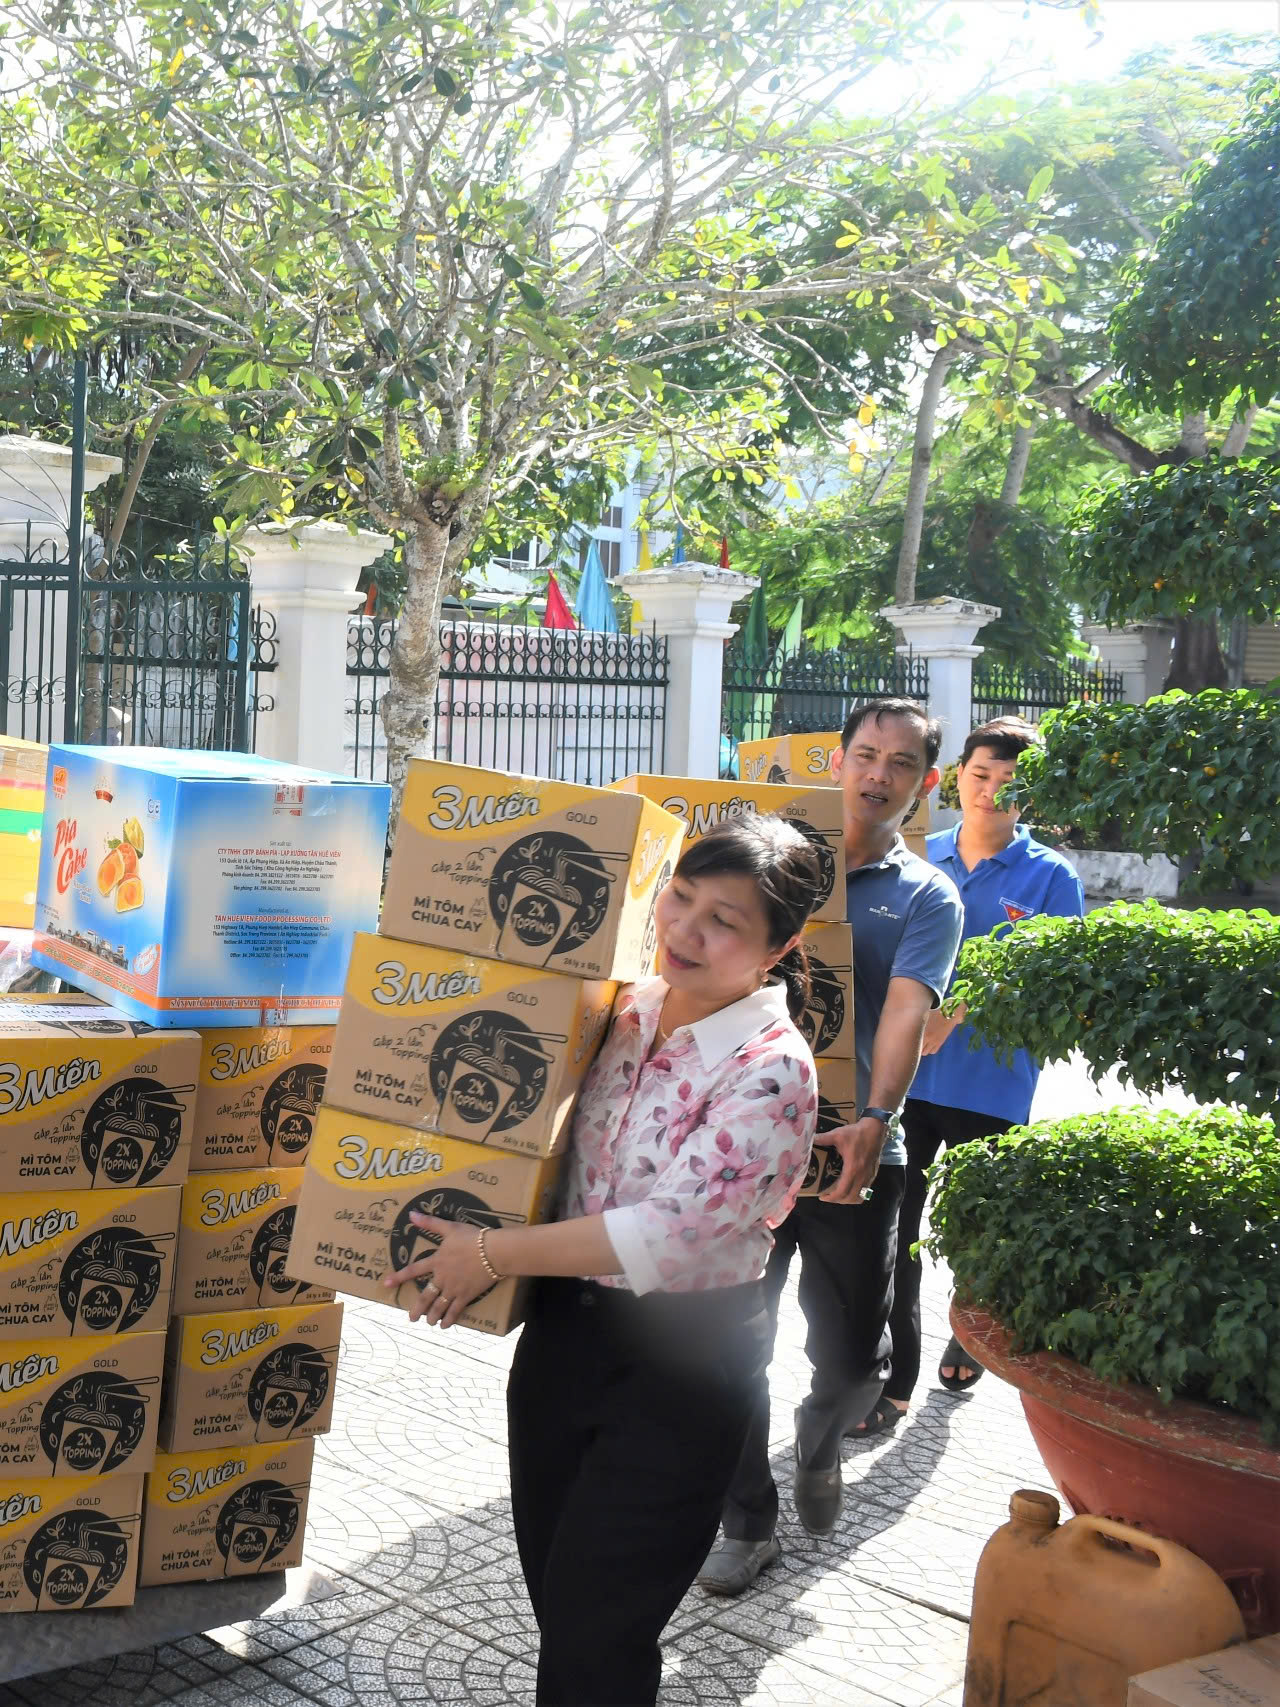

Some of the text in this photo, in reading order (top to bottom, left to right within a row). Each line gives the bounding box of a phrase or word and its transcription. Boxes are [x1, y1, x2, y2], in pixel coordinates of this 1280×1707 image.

[566, 811, 598, 826] GOLD
[786, 808, 806, 816] GOLD
[414, 895, 464, 915] MÌ TÔM
[528, 900, 548, 918] 2X
[411, 911, 482, 933] CHUA CAY
[512, 913, 555, 937] TOPPING
[506, 992, 538, 1007] GOLD
[311, 1046, 333, 1054] GOLD
[135, 1065, 158, 1074] GOLD
[376, 1073, 405, 1090] TÔM
[353, 1083, 423, 1108] CHUA CAY
[289, 1117, 303, 1132] 2X
[221, 1131, 243, 1144] TÔM
[278, 1132, 309, 1144] TOPPING
[115, 1143, 131, 1157] 2X
[204, 1144, 257, 1156] CHUA CAY
[20, 1153, 62, 1166] MÌ TÔM
[103, 1158, 138, 1170] TOPPING
[19, 1166, 77, 1177] CHUA CAY
[468, 1170, 499, 1186] GOLD
[112, 1214, 135, 1223] GOLD
[337, 1246, 366, 1264] TÔM
[314, 1255, 383, 1282] CHUA CAY
[14, 1302, 39, 1313] TÔM
[32, 1314, 55, 1323] CAY
[297, 1325, 318, 1334] GOLD
[94, 1359, 118, 1368] GOLD
[13, 1455, 36, 1463] CAY
[266, 1461, 287, 1471] GOLD
[76, 1497, 100, 1506] GOLD
[177, 1547, 199, 1560] TÔM
[161, 1557, 213, 1572] CHUA CAY
